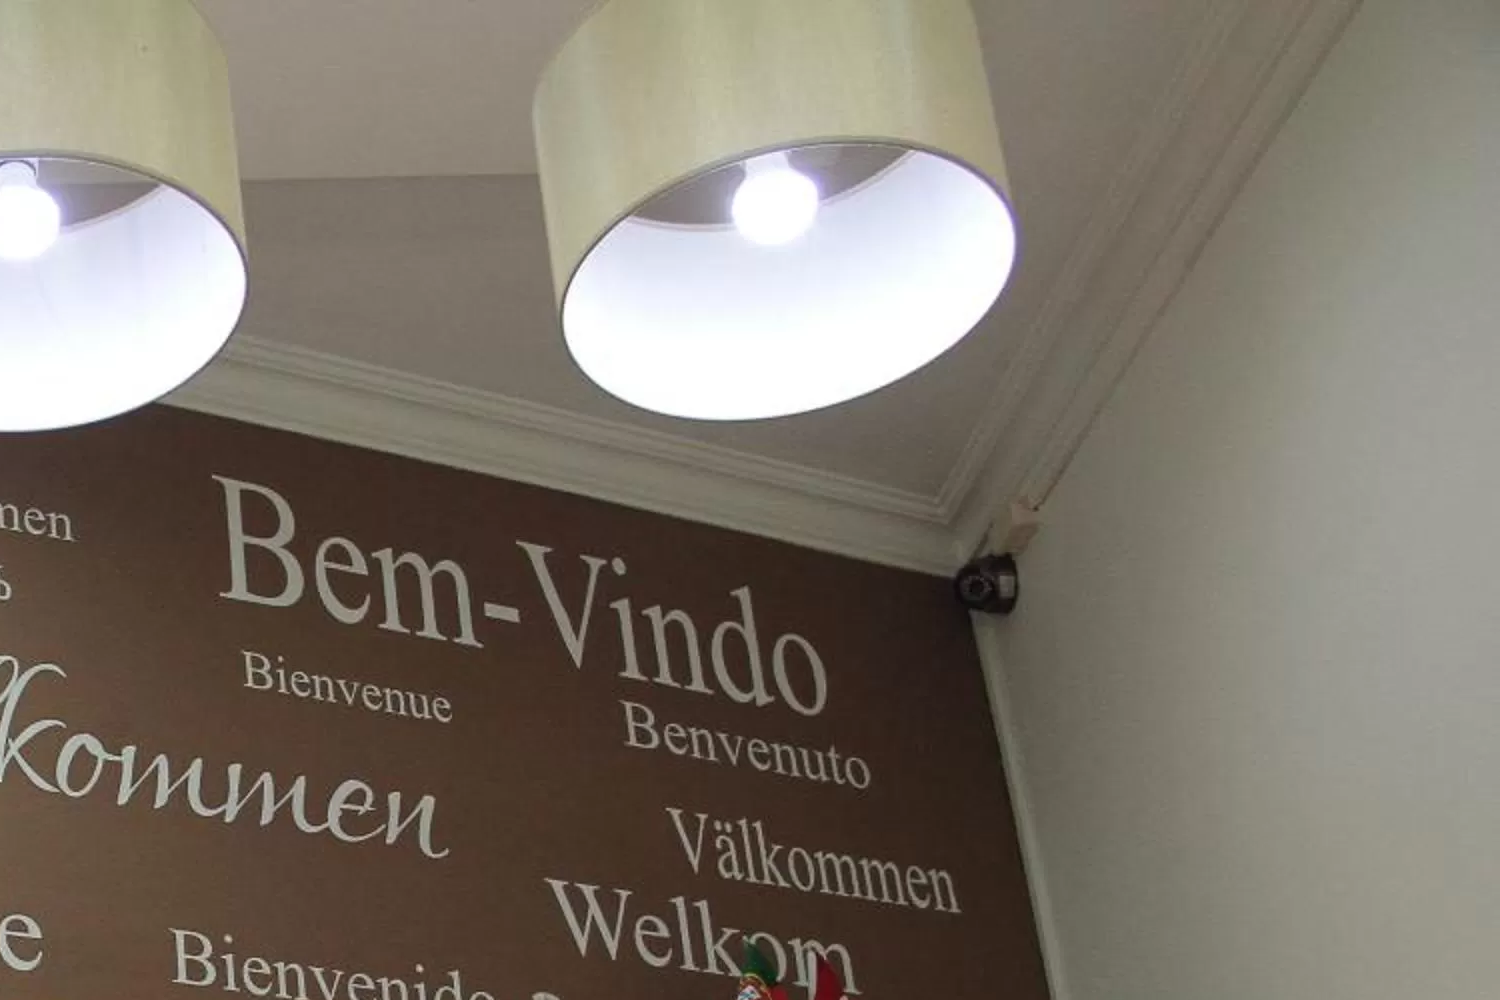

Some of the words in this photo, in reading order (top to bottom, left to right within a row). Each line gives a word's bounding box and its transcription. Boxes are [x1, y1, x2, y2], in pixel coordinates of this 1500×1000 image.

[212, 475, 828, 715] Bem-Vindo
[242, 650, 453, 723] Bienvenue
[620, 700, 870, 788] Benvenuto
[666, 808, 961, 913] Välkommen
[544, 878, 863, 995] Welkom
